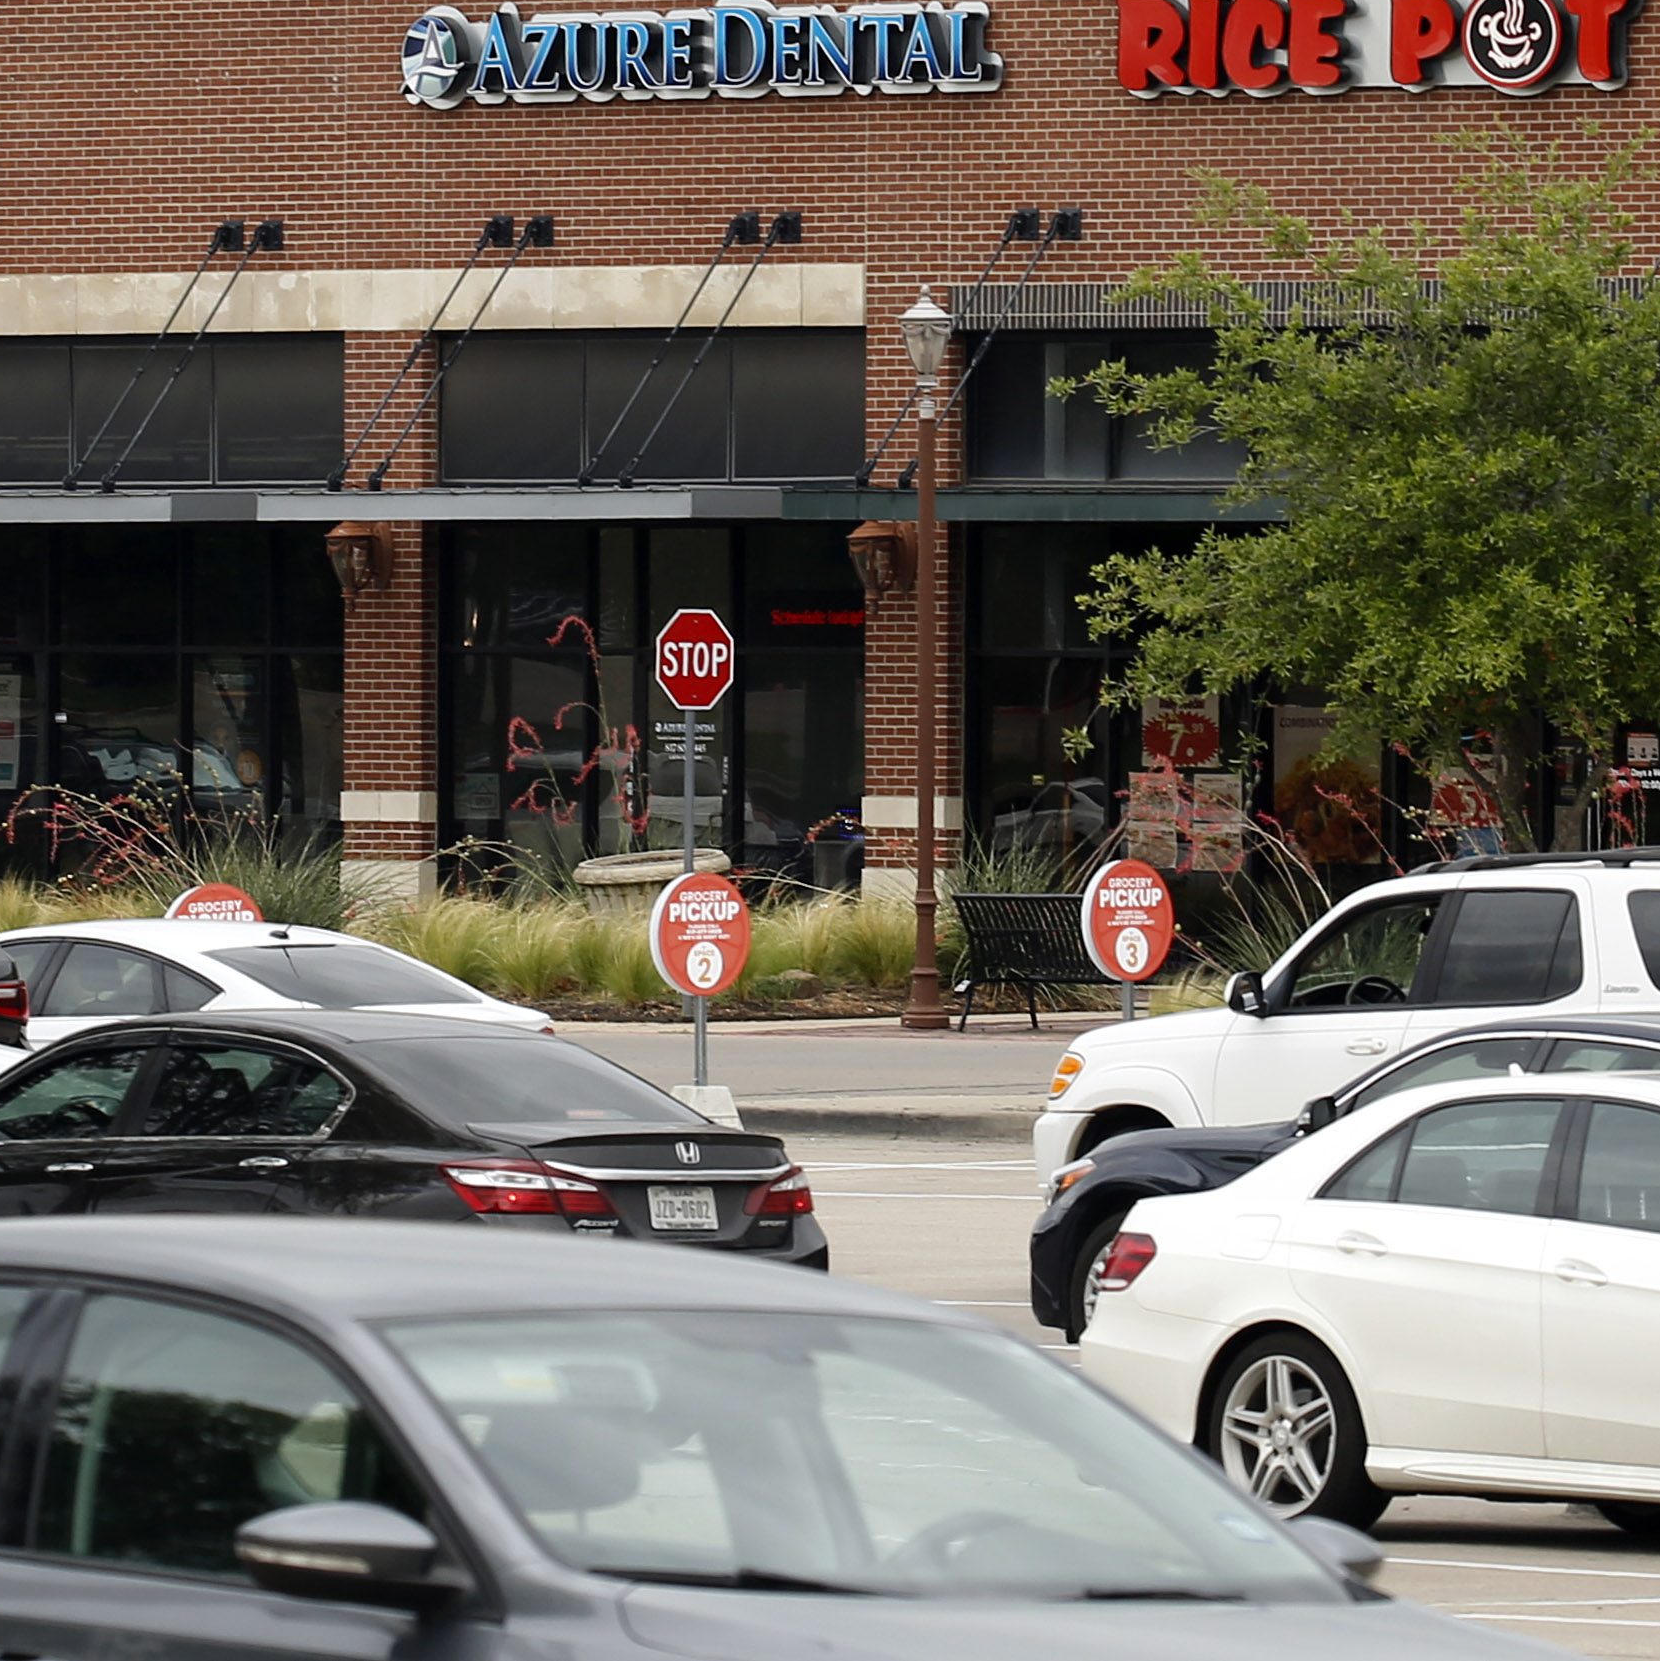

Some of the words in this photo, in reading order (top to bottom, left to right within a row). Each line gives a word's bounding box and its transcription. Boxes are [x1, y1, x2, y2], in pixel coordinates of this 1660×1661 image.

[466, 11, 694, 94] AZURE
[708, 6, 983, 90] DENTAL
[662, 641, 729, 678] STOP
[1108, 877, 1153, 888] GROCERY
[188, 899, 243, 913] GROCERY
[679, 890, 729, 902] GROCERY
[1099, 888, 1162, 908] PICKUP
[669, 901, 740, 922] PICKUP
[1126, 943, 1138, 968] 3
[698, 957, 711, 983] 2
